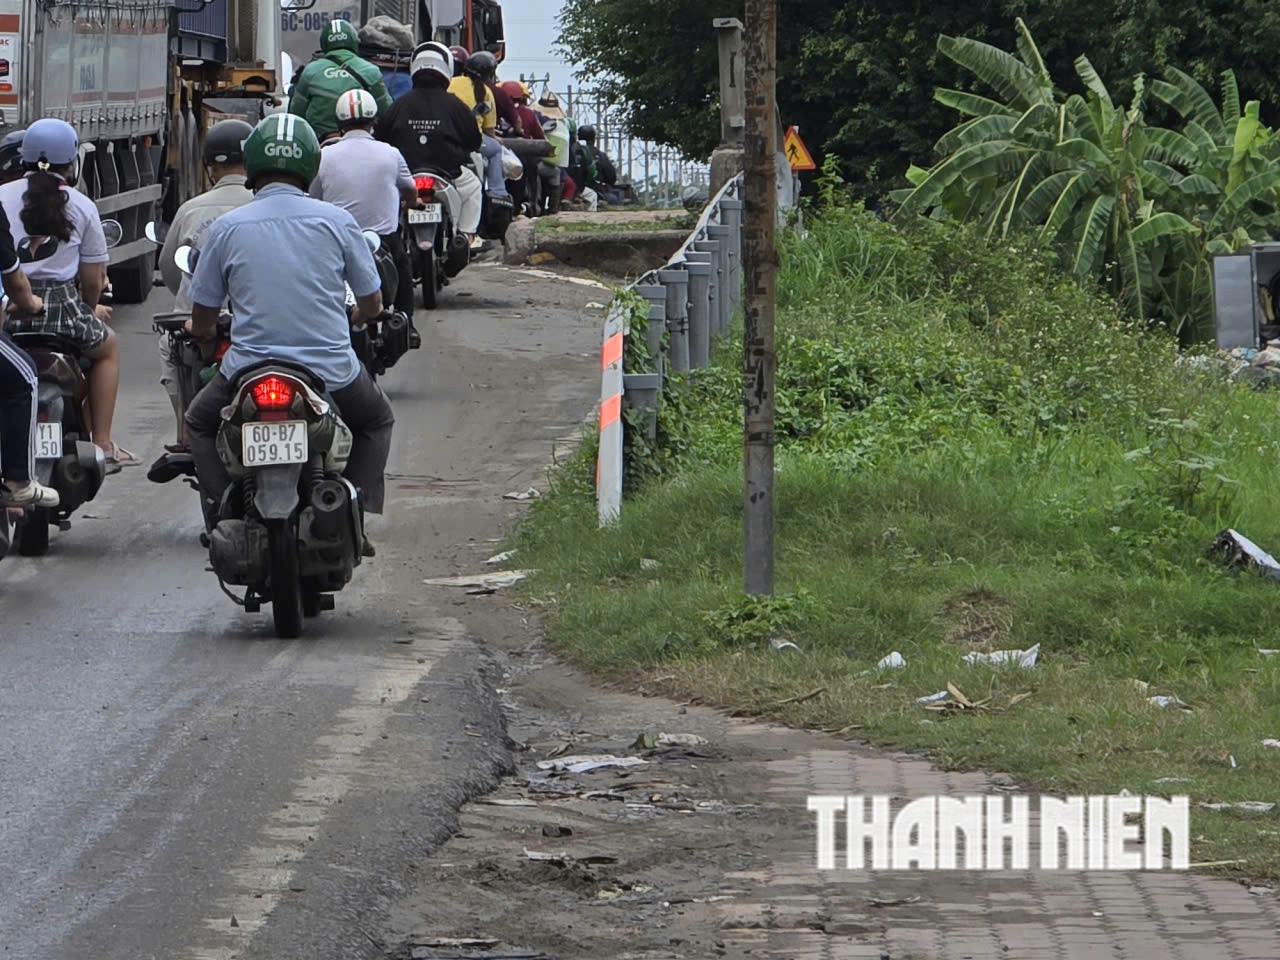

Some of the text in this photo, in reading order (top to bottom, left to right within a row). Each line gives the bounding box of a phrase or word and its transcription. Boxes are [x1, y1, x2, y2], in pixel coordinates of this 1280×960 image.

[328, 32, 348, 42] Grab
[324, 67, 353, 79] Gra
[264, 143, 303, 159] Grab
[253, 424, 297, 443] 60-B7
[247, 442, 304, 463] 059.15
